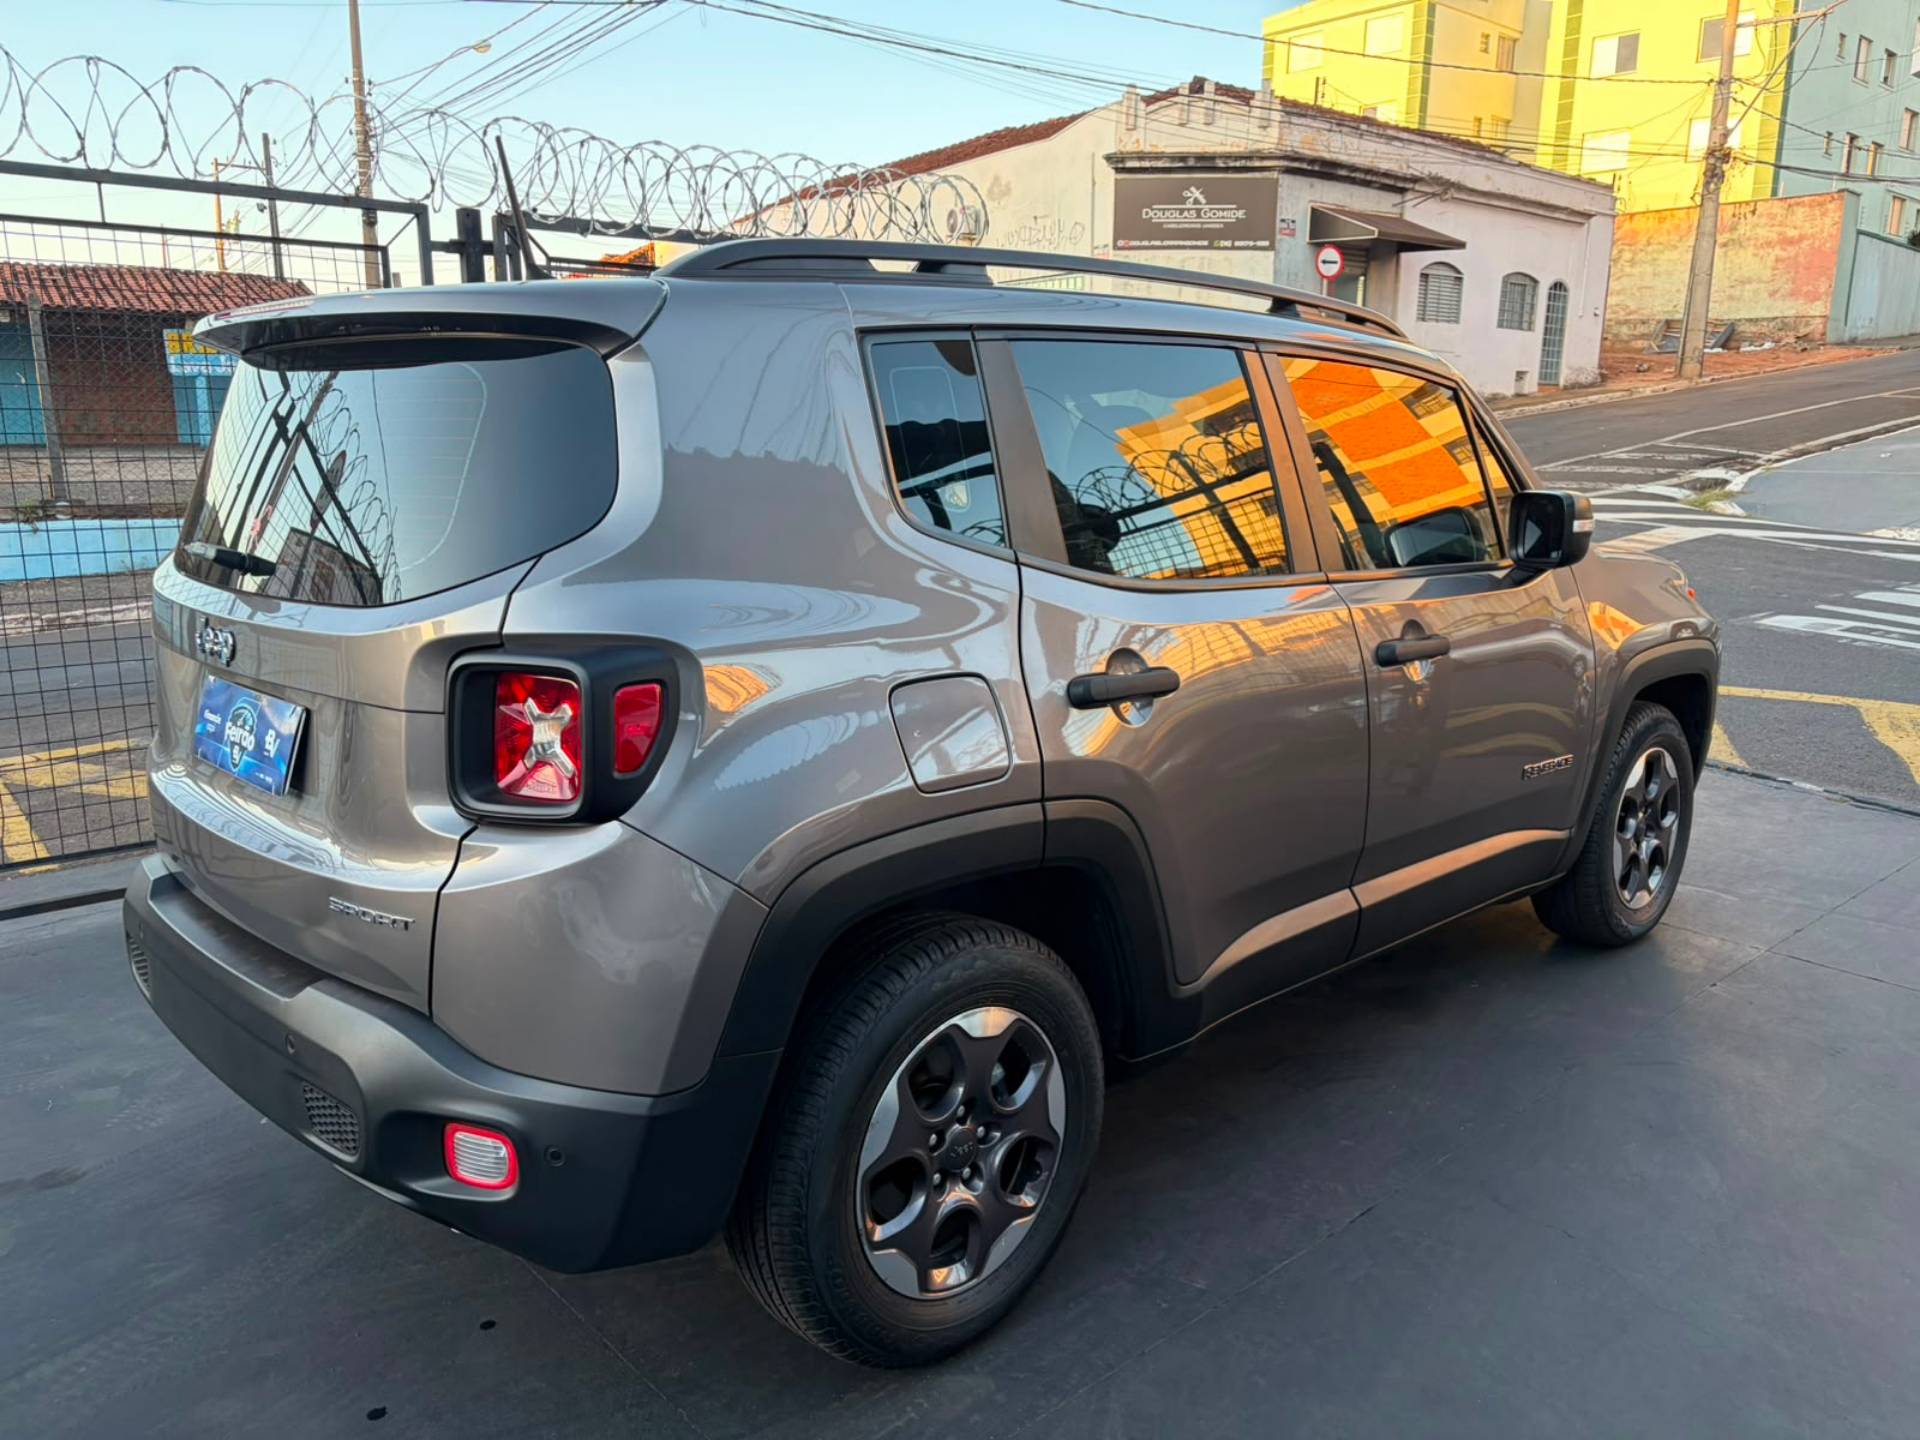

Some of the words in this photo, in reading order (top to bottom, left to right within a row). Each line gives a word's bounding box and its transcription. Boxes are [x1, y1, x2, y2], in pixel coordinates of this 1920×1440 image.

[1142, 208, 1196, 219] DOUGLAS
[1201, 208, 1247, 219] GOMIDE
[327, 896, 416, 931] SPORT
